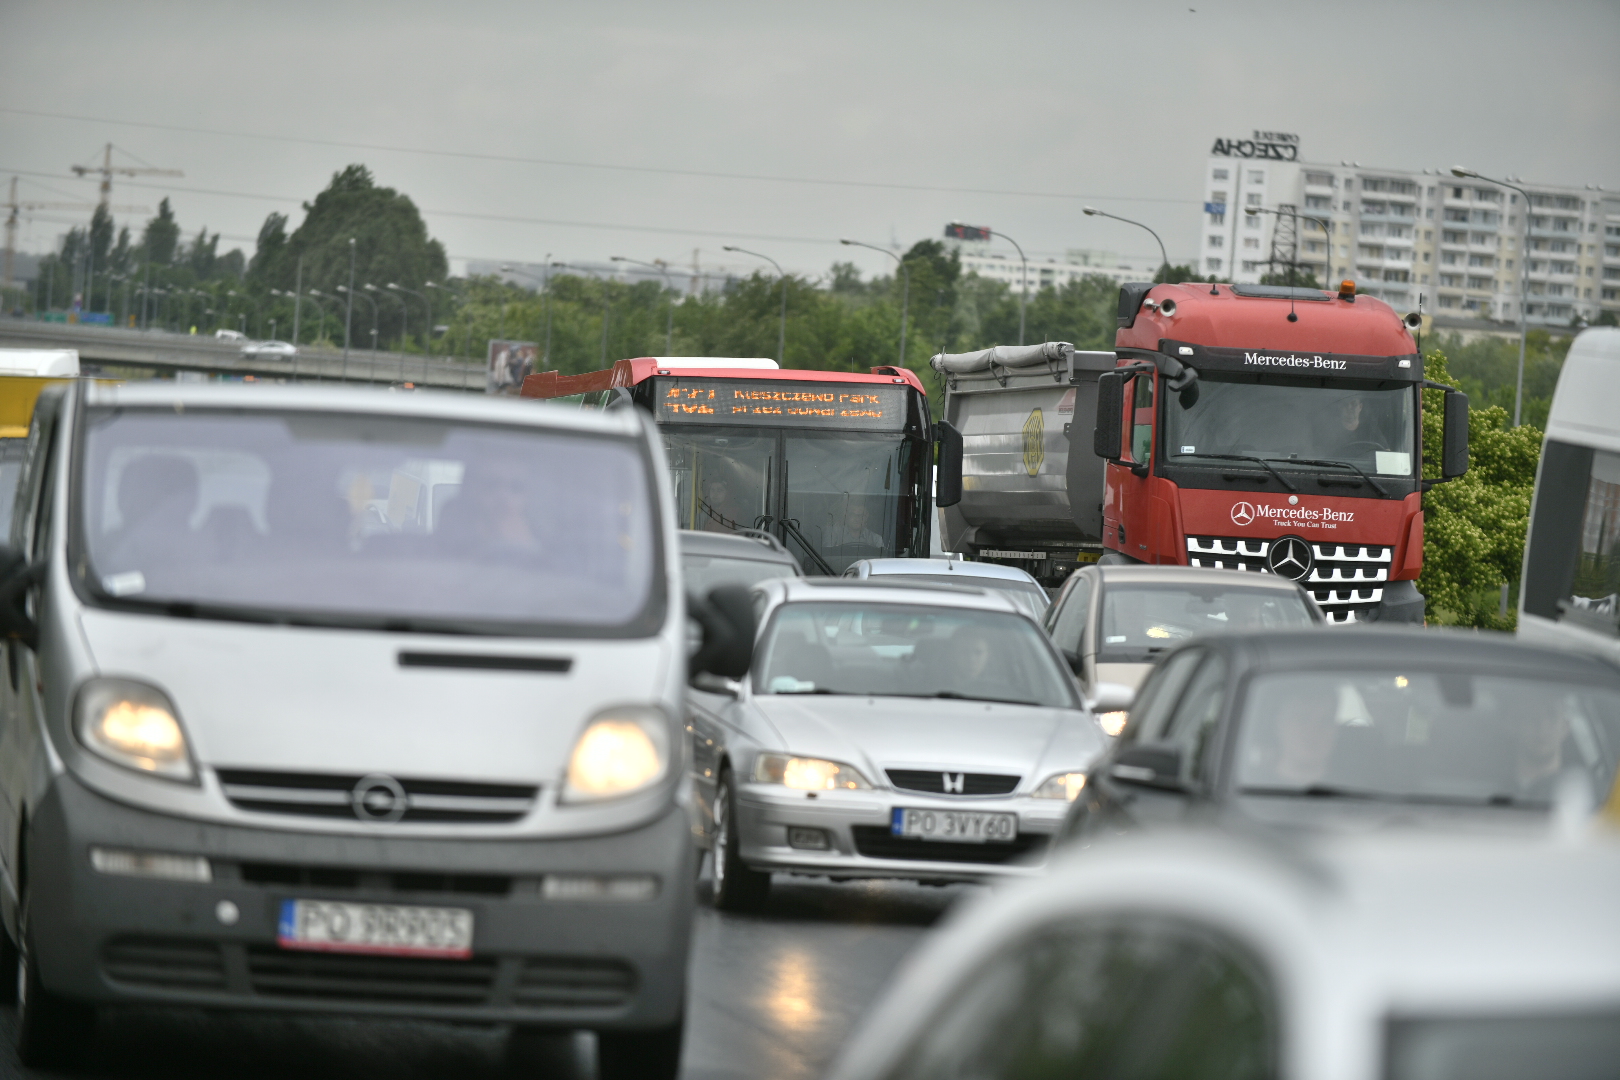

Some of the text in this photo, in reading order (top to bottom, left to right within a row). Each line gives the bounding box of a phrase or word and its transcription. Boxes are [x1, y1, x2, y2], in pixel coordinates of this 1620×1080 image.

[1244, 352, 1346, 370] Mercedes-Benz
[1256, 504, 1355, 522] Mercedes-Benz
[1273, 519, 1291, 527] Truck
[1293, 520, 1305, 528] You
[1321, 521, 1337, 529] Trust
[905, 808, 1012, 838] PO 3VY60
